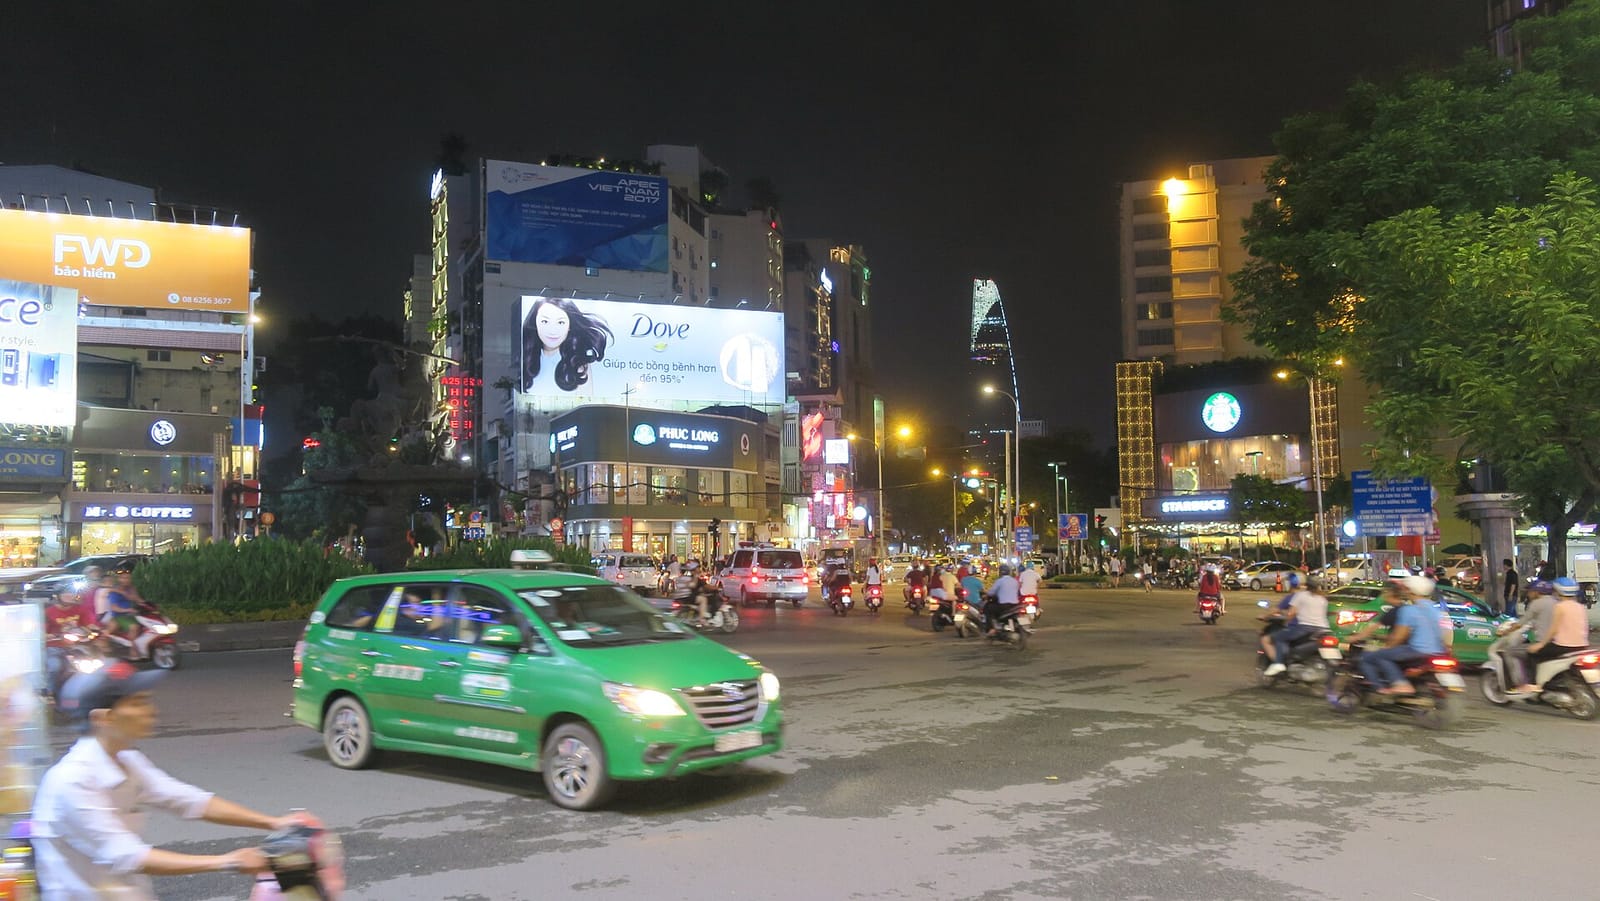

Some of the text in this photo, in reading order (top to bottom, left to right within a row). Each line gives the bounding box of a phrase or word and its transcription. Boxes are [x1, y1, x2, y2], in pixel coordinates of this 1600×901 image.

[588, 183, 660, 197] VIET NAM
[617, 178, 660, 190] APEC
[623, 193, 660, 204] 2017
[53, 233, 151, 268] FWD
[54, 265, 116, 279] bảo hiểm
[630, 313, 690, 339] Dove
[602, 358, 626, 371] Giúp
[628, 359, 643, 370] tóc
[697, 362, 717, 373] hơn
[441, 377, 461, 385] A25
[691, 429, 719, 443] LONG
[0, 452, 57, 466] ONG
[130, 507, 193, 519] COFFEE
